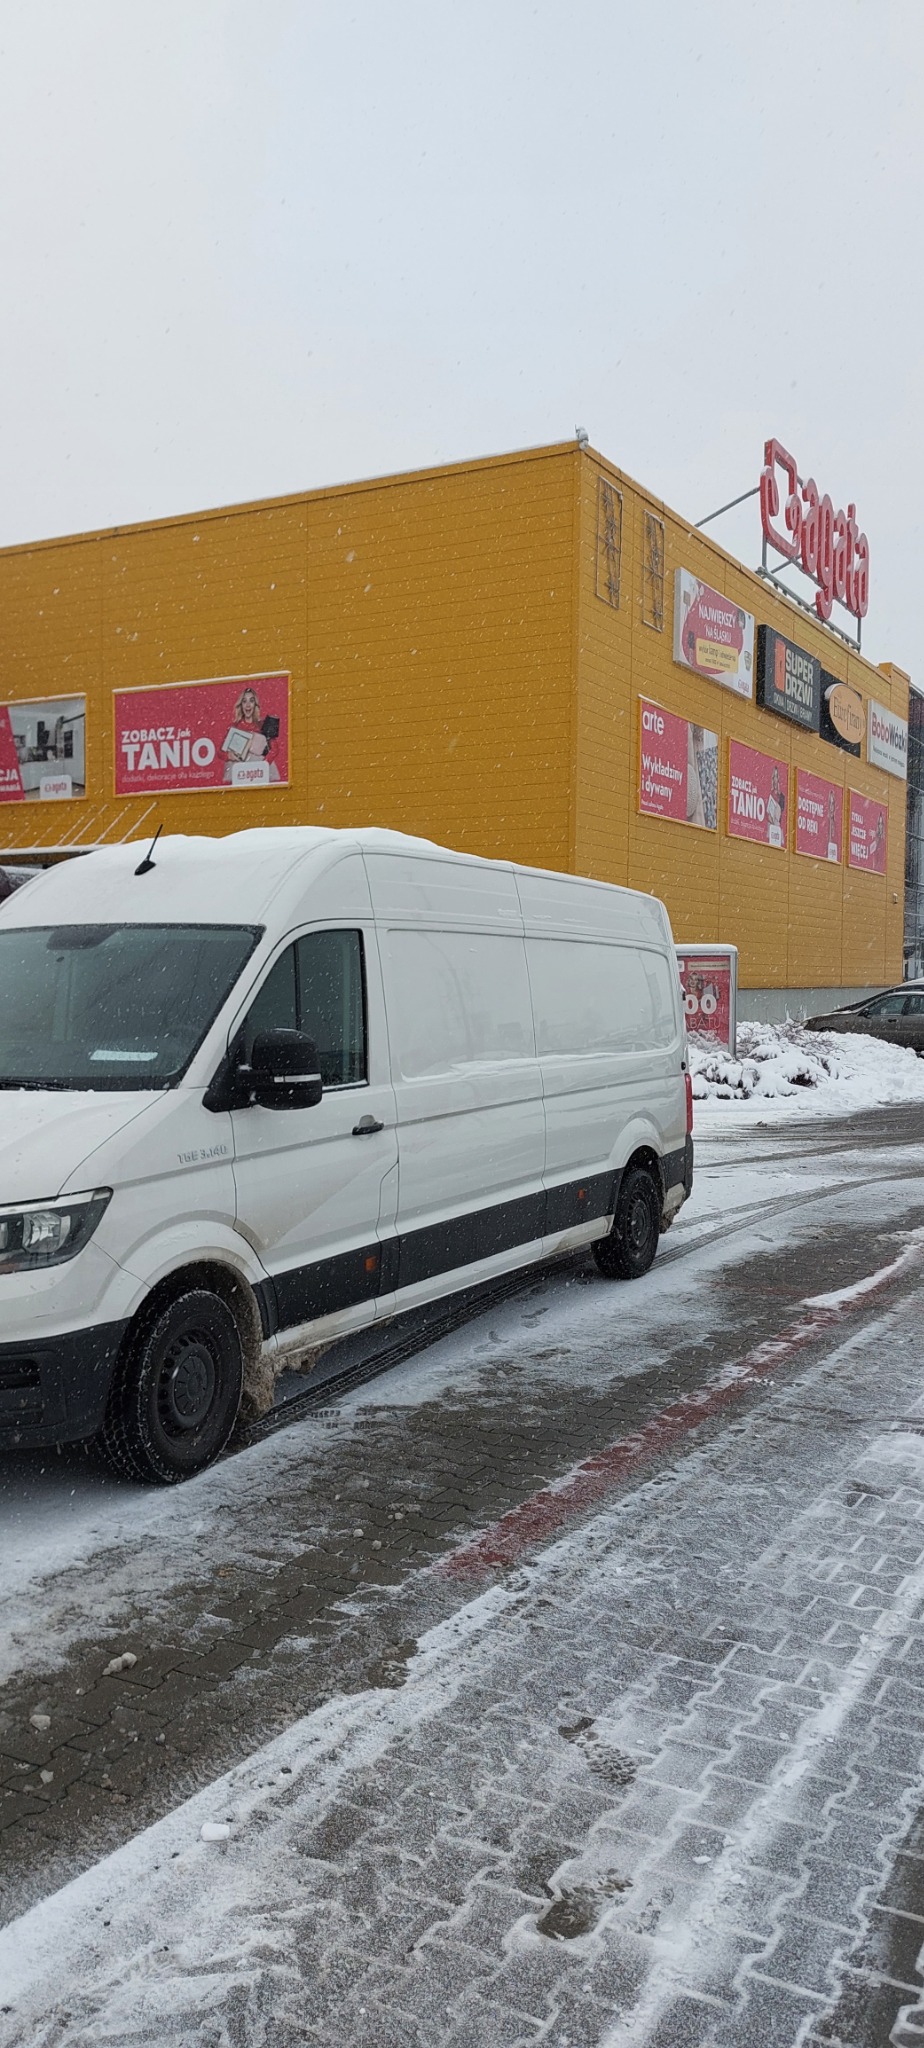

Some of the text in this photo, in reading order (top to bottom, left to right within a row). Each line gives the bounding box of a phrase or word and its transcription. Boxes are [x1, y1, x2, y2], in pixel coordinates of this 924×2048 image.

[801, 477, 869, 619] agata
[698, 602, 737, 628] NAJWIĘKSZY
[785, 648, 814, 686] SUPER
[785, 671, 813, 708] DRZWI
[121, 727, 191, 743] ZOBACZ jak
[642, 710, 664, 735] arte
[121, 737, 216, 771] TANIO
[246, 768, 264, 781] agata
[642, 753, 683, 786] Wykładziny
[731, 775, 752, 793] ZOBACZ
[645, 775, 673, 802] dywany
[731, 788, 765, 822] TANIO
